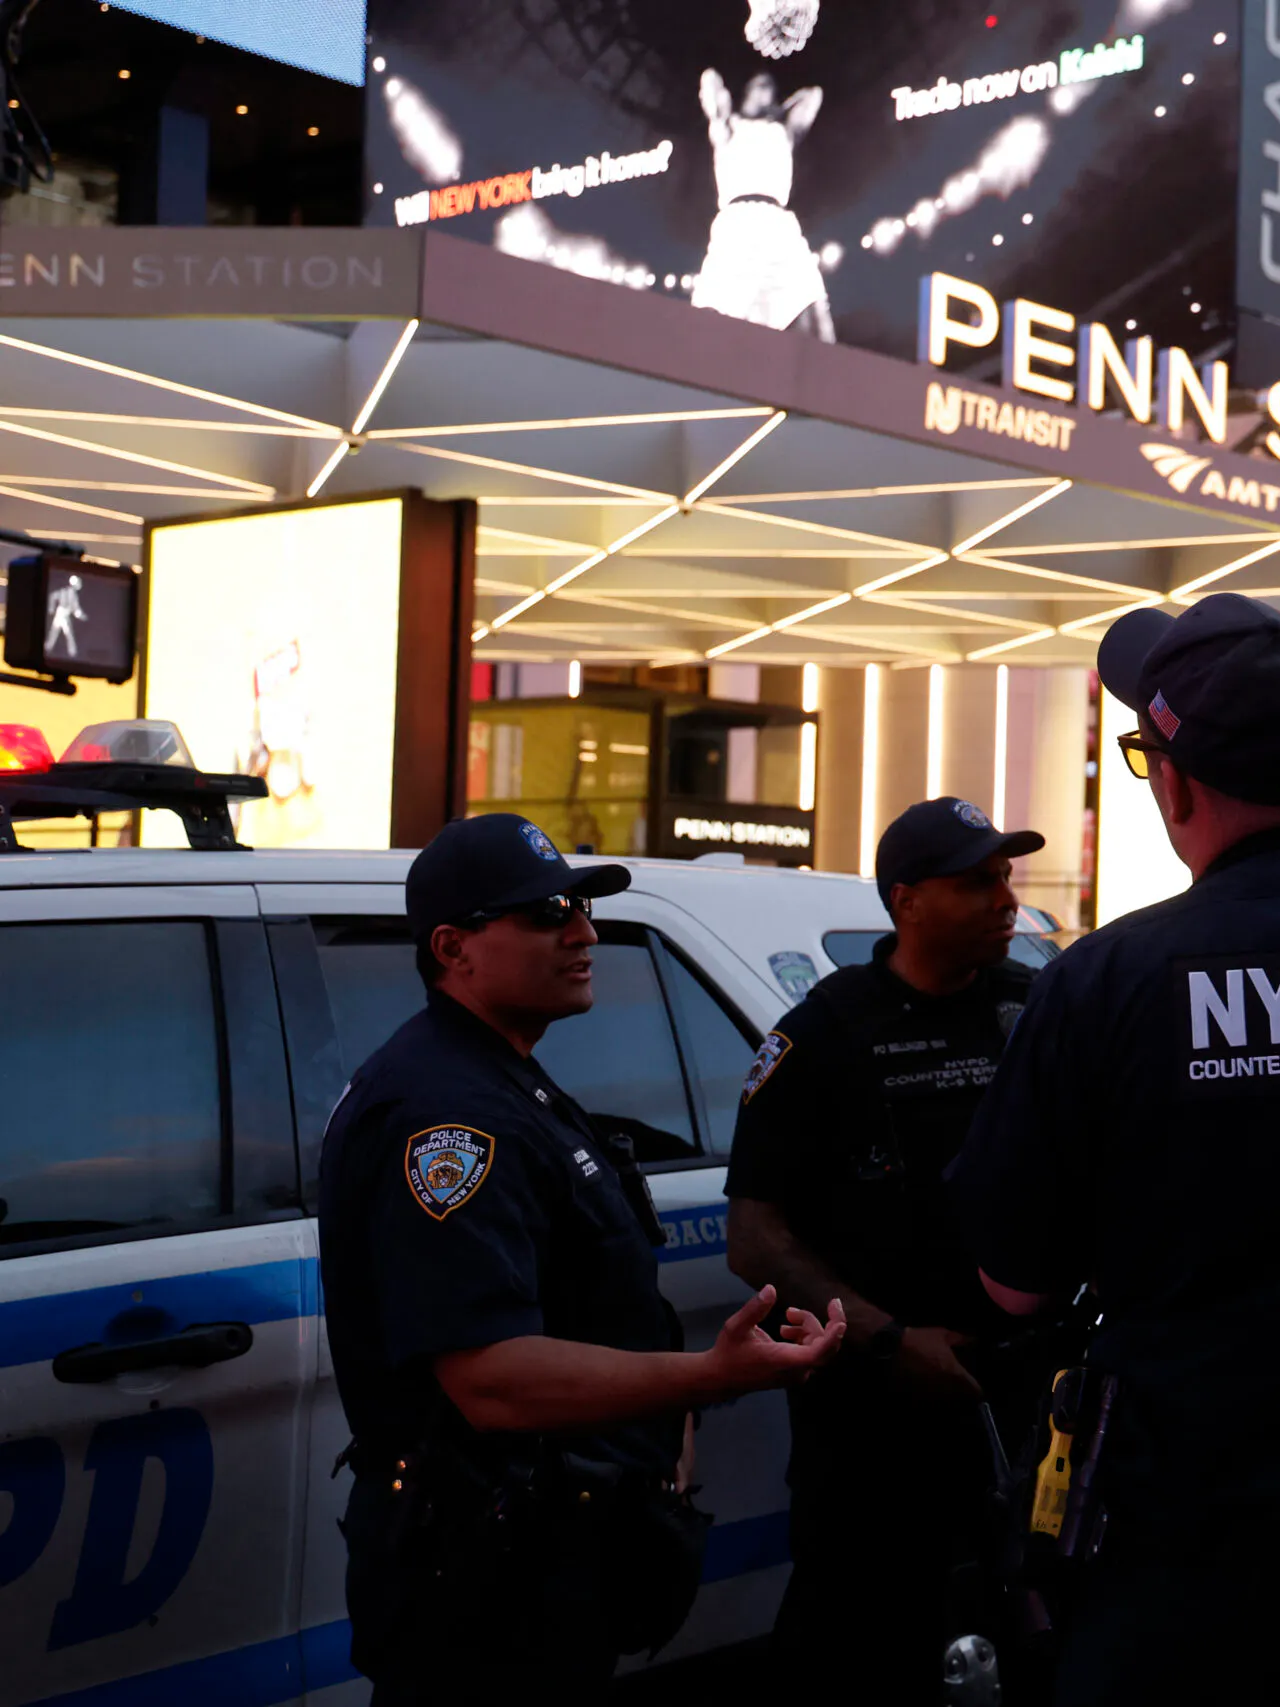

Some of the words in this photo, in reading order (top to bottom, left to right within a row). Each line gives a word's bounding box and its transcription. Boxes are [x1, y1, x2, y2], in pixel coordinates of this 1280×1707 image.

[891, 76, 962, 121] Trade
[963, 69, 1020, 106] now
[1020, 61, 1057, 93] on
[430, 183, 477, 220] NEW
[475, 171, 532, 210] YORK
[531, 163, 584, 197] bring
[585, 156, 601, 188] it
[132, 254, 384, 289] STATION
[928, 271, 1228, 444] PENN
[961, 392, 1076, 451] TRANSIT
[674, 817, 731, 842] PENN
[731, 821, 810, 848] STATION
[944, 1057, 989, 1069] NYPD
[936, 1078, 965, 1089] K-9
[413, 1138, 486, 1157] DEPARTMENT
[429, 1130, 472, 1143] POLICE
[410, 1168, 425, 1191] CITY
[421, 1191, 433, 1205] OF
[446, 1188, 468, 1206] NEW
[465, 1162, 487, 1190] YORK
